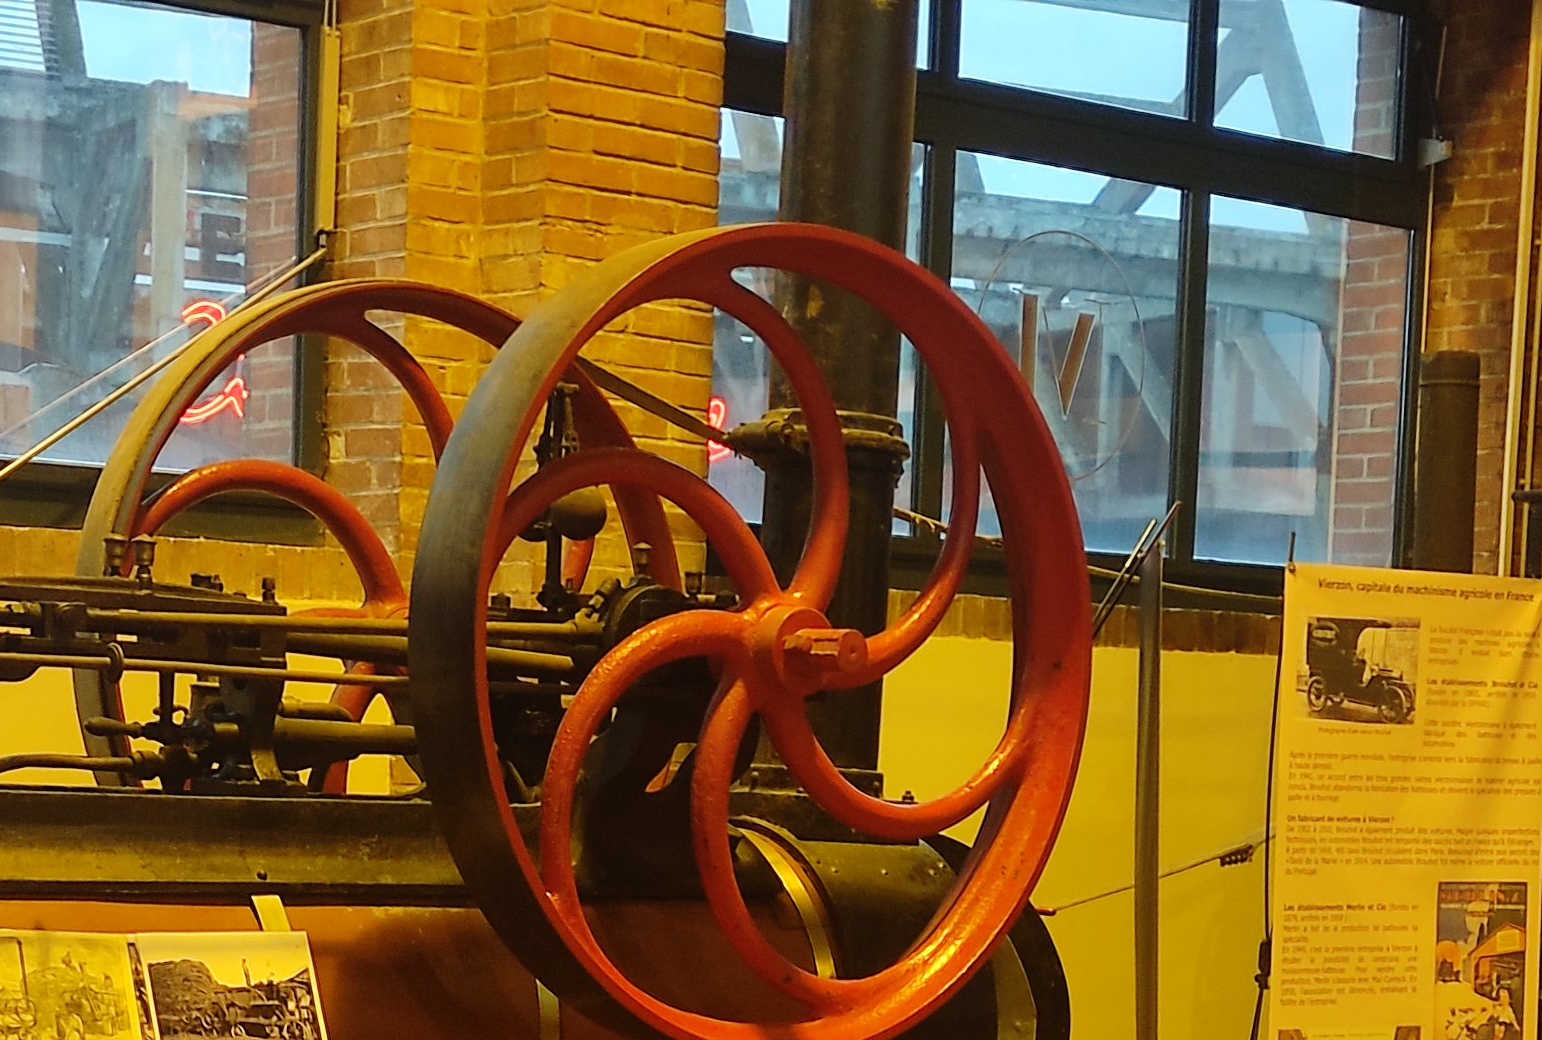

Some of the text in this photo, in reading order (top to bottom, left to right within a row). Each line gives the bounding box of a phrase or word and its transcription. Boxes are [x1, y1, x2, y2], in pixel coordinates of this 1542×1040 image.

[1318, 578, 1534, 602] Vierzon, capitale du machinisme agricole en France
